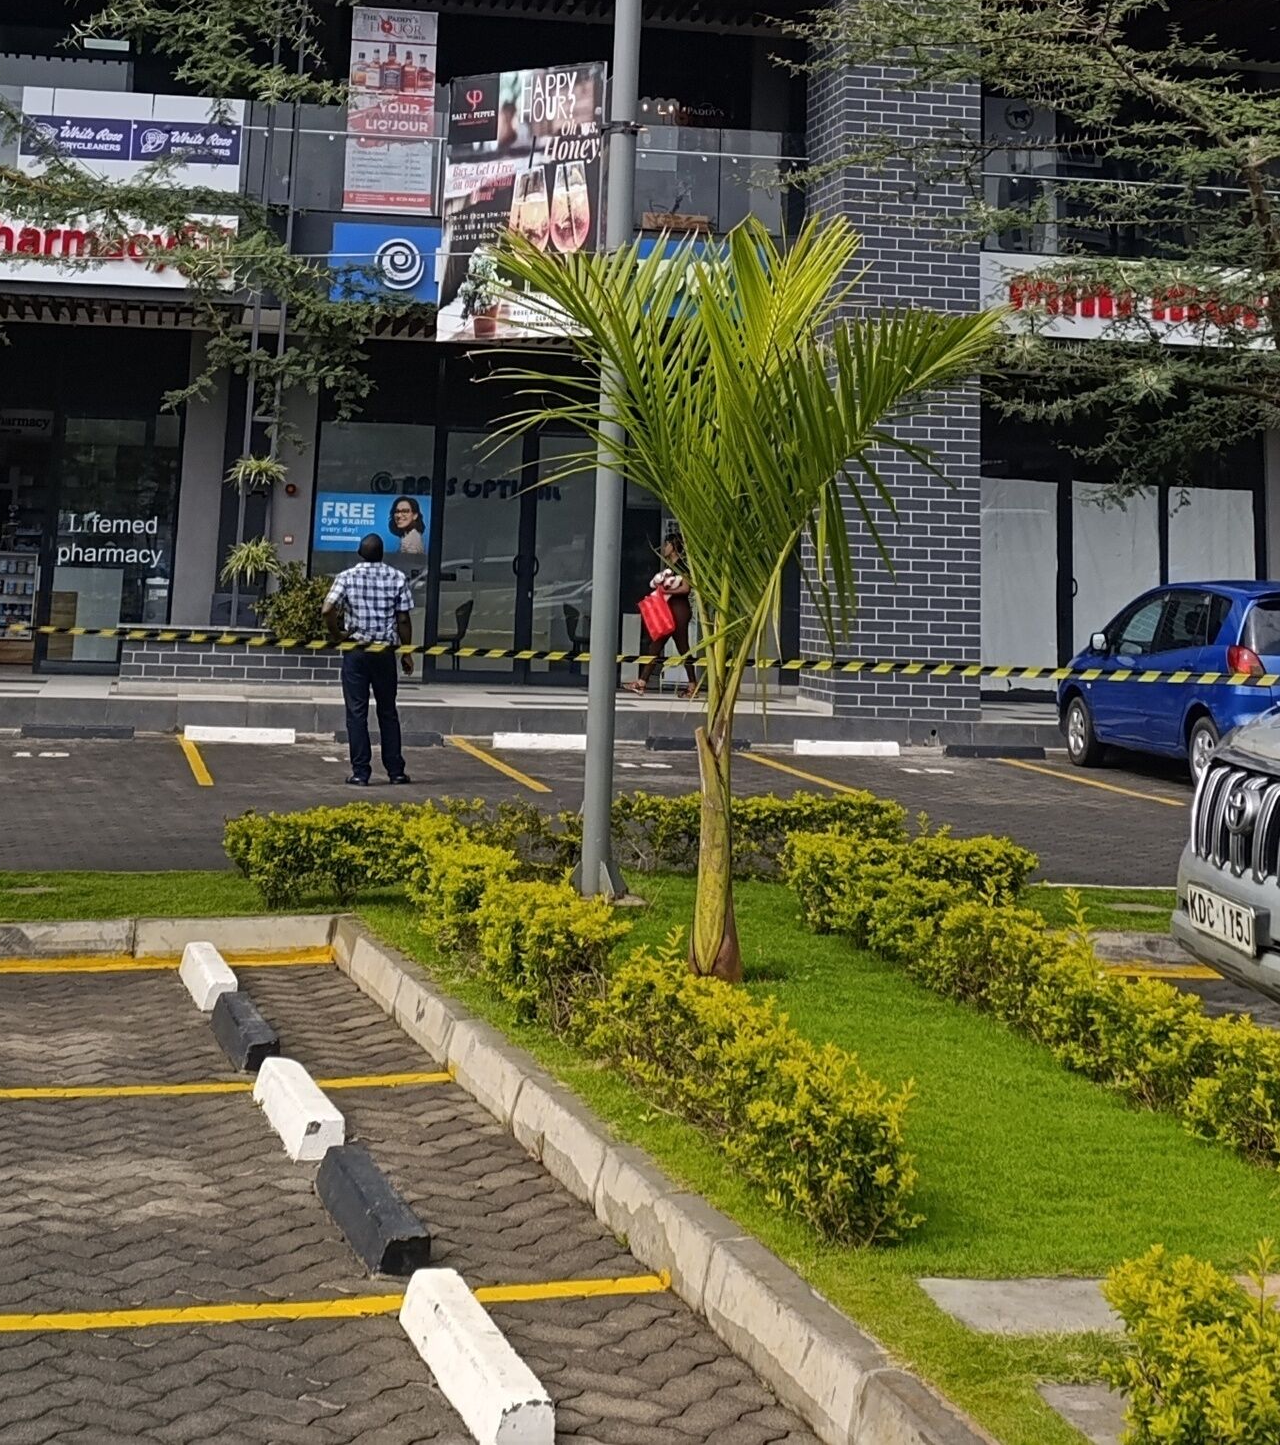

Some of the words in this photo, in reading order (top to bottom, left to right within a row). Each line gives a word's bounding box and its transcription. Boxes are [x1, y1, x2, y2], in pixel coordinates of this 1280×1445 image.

[522, 71, 578, 99] HAPPY
[380, 103, 420, 115] YOUR
[521, 95, 576, 123] HOUR?
[60, 125, 95, 140] White
[96, 128, 124, 142] Rose
[170, 131, 205, 145] White
[206, 132, 233, 146] Rose
[322, 501, 376, 519] FREE
[342, 518, 375, 526] exams
[57, 542, 163, 569] pharmacy
[1189, 889, 1215, 929] KDC
[1221, 904, 1251, 947] 115J
